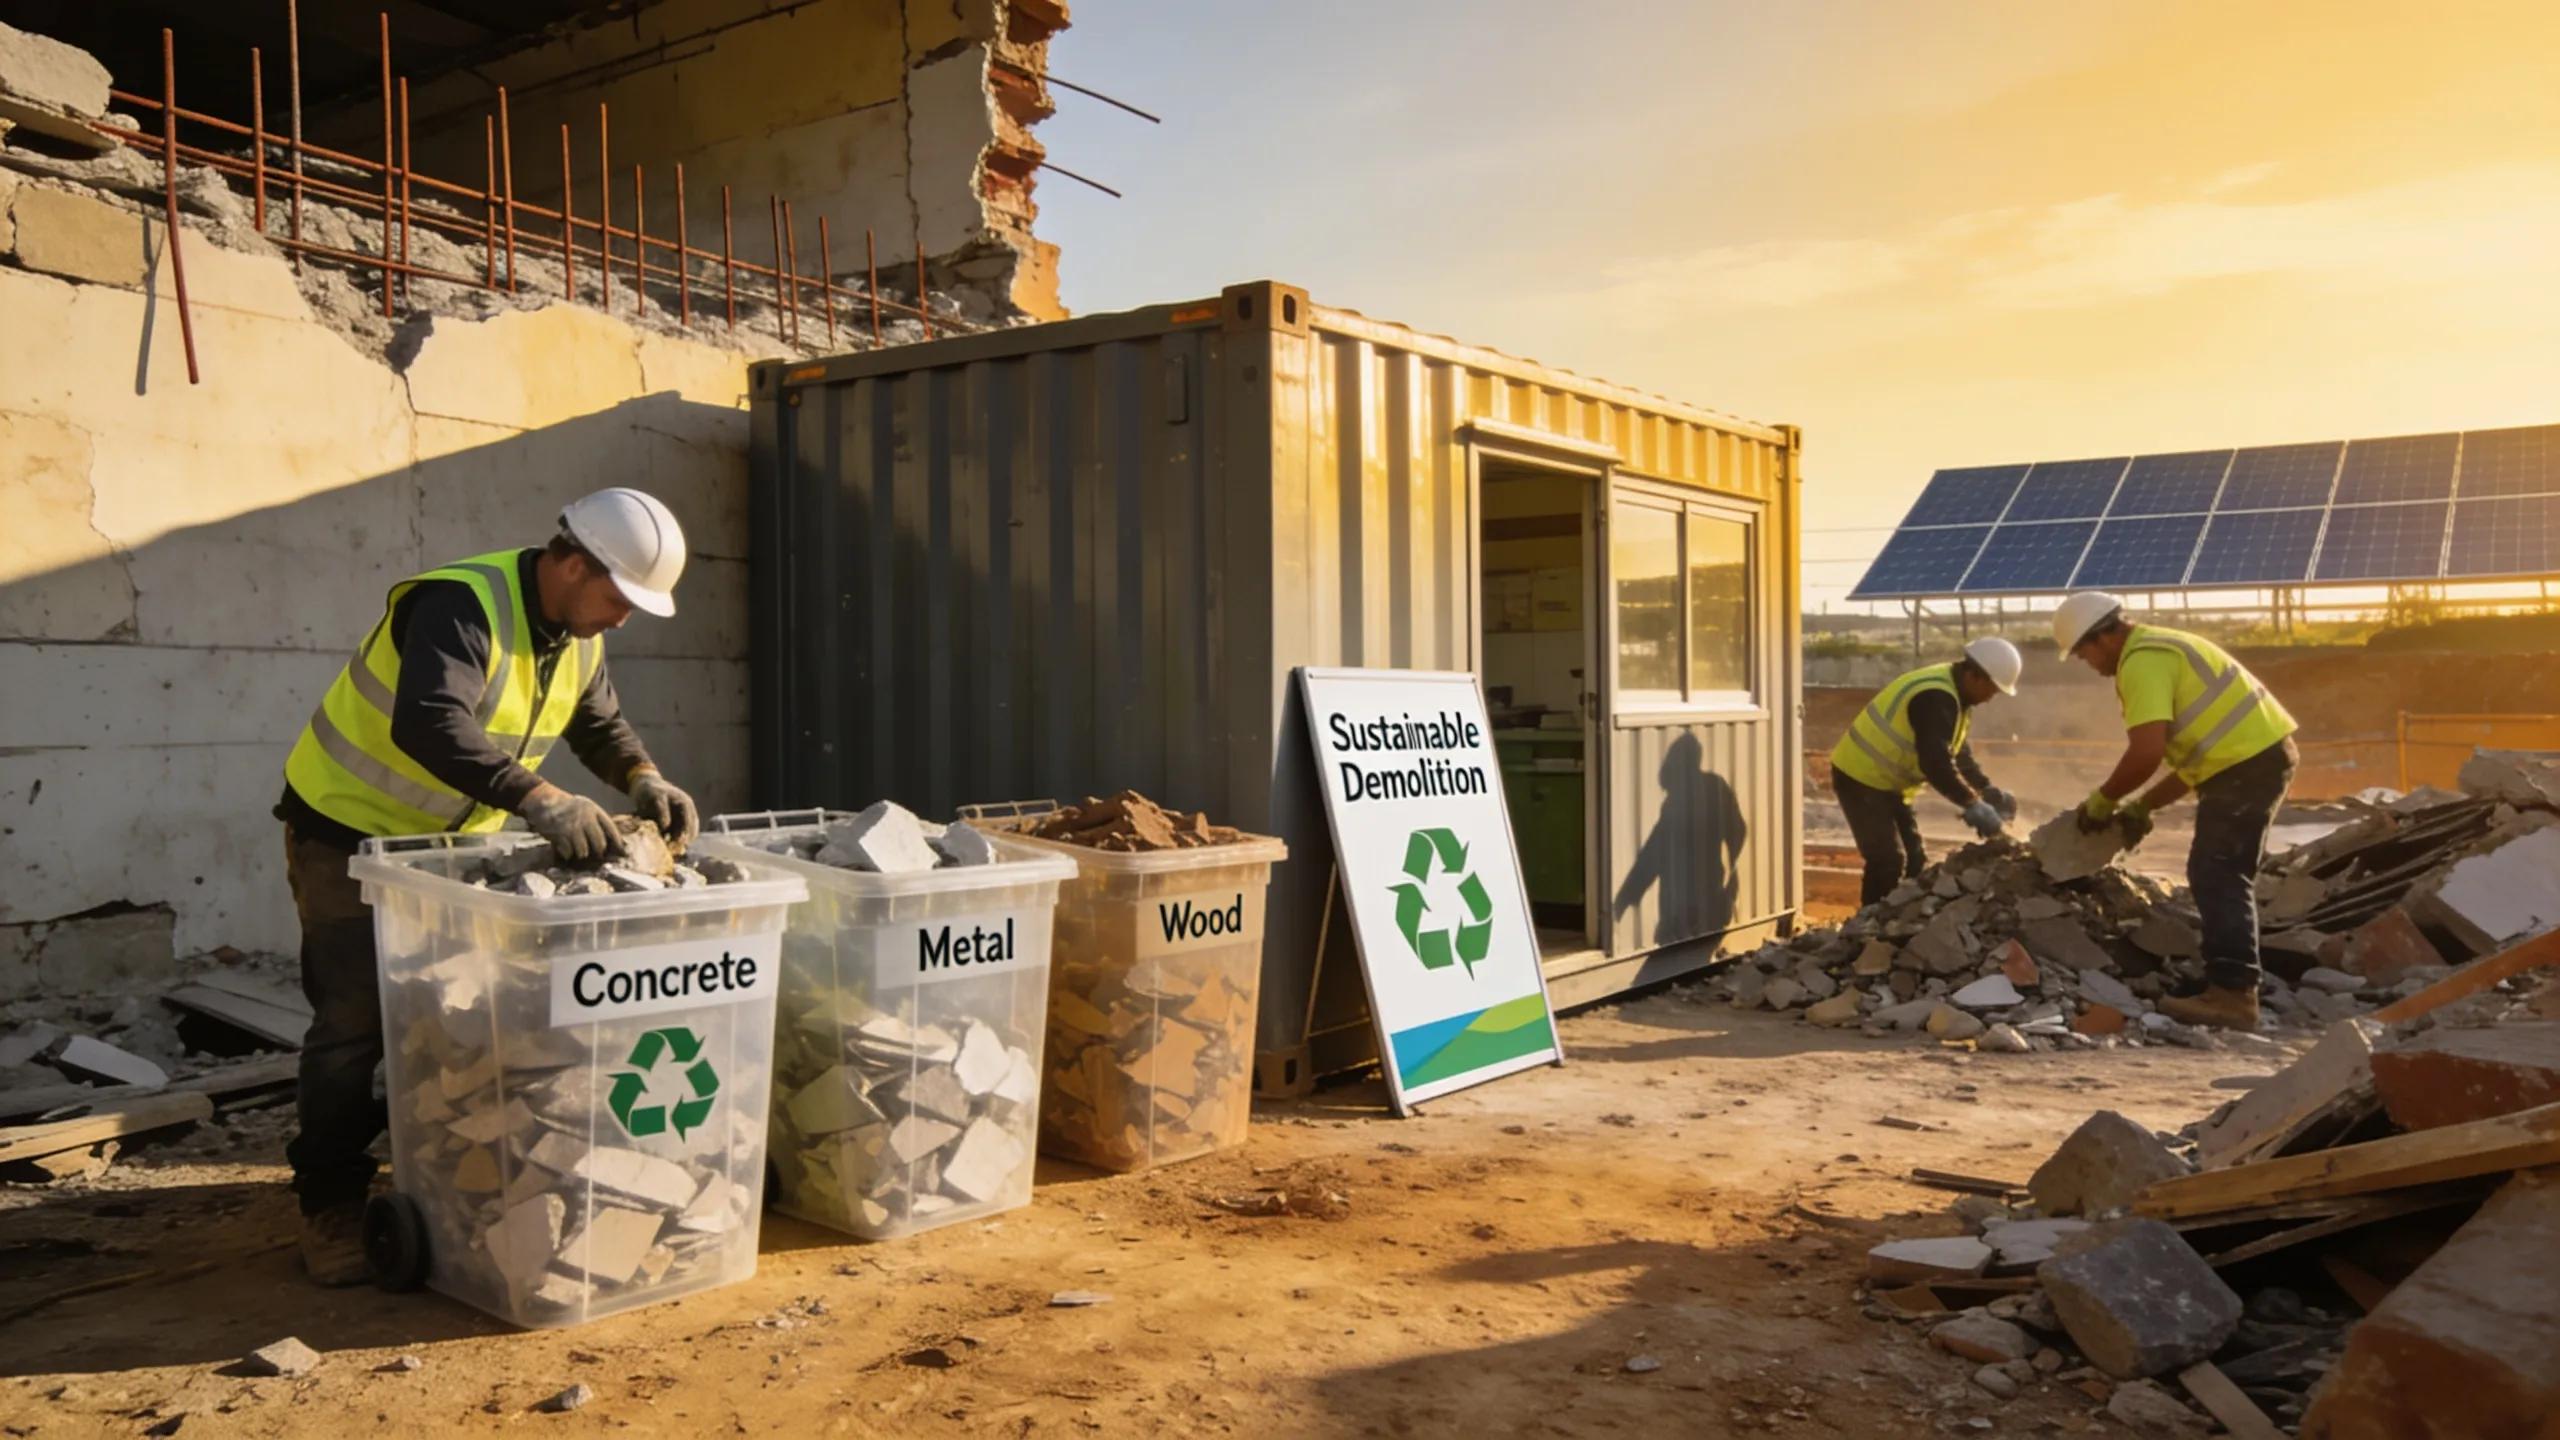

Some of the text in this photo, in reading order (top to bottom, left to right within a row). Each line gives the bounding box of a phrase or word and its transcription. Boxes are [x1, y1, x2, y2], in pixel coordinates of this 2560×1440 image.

[1339, 757, 1488, 802] Demolition
[1159, 893, 1243, 943] Wood
[918, 917, 1014, 972] Metal
[572, 951, 757, 1007] Concrete
